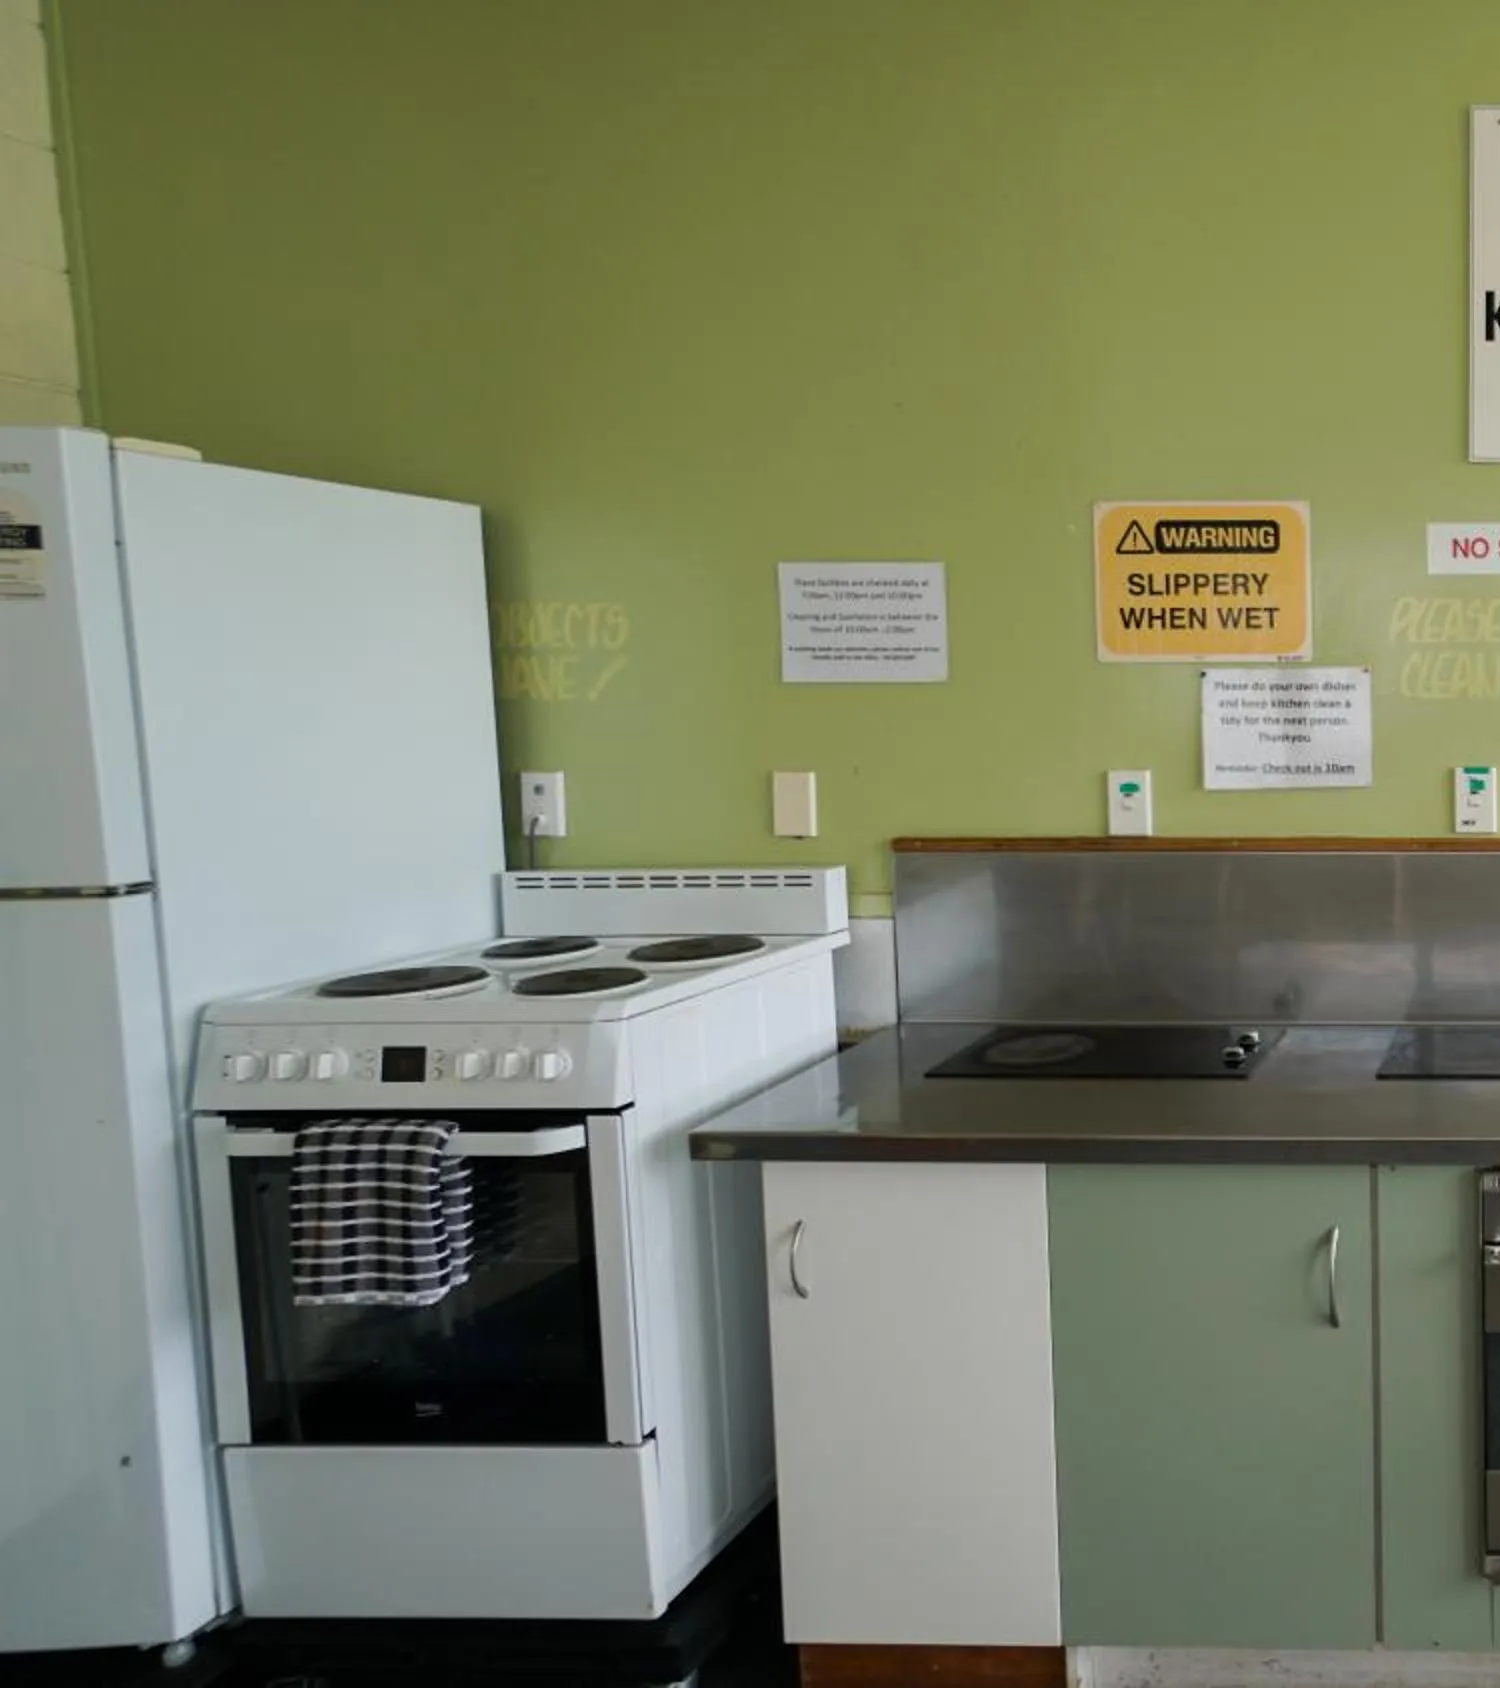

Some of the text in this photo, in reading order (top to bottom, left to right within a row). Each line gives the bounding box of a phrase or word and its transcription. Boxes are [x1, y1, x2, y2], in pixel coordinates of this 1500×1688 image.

[1160, 527, 1276, 549] WARNING
[1451, 537, 1490, 560] NO
[1127, 573, 1269, 597] SLIPPERY
[1119, 607, 1280, 630] WHEN WET
[1214, 681, 1249, 692] Please
[1251, 681, 1266, 691] do
[1269, 683, 1293, 693] your
[1295, 683, 1319, 692] own
[1218, 698, 1239, 709] and
[1271, 698, 1310, 709] kitchen
[1313, 698, 1342, 709] clean
[1244, 714, 1260, 725] for
[1262, 715, 1280, 725] the
[1262, 762, 1292, 775] Check
[1294, 764, 1311, 775] out
